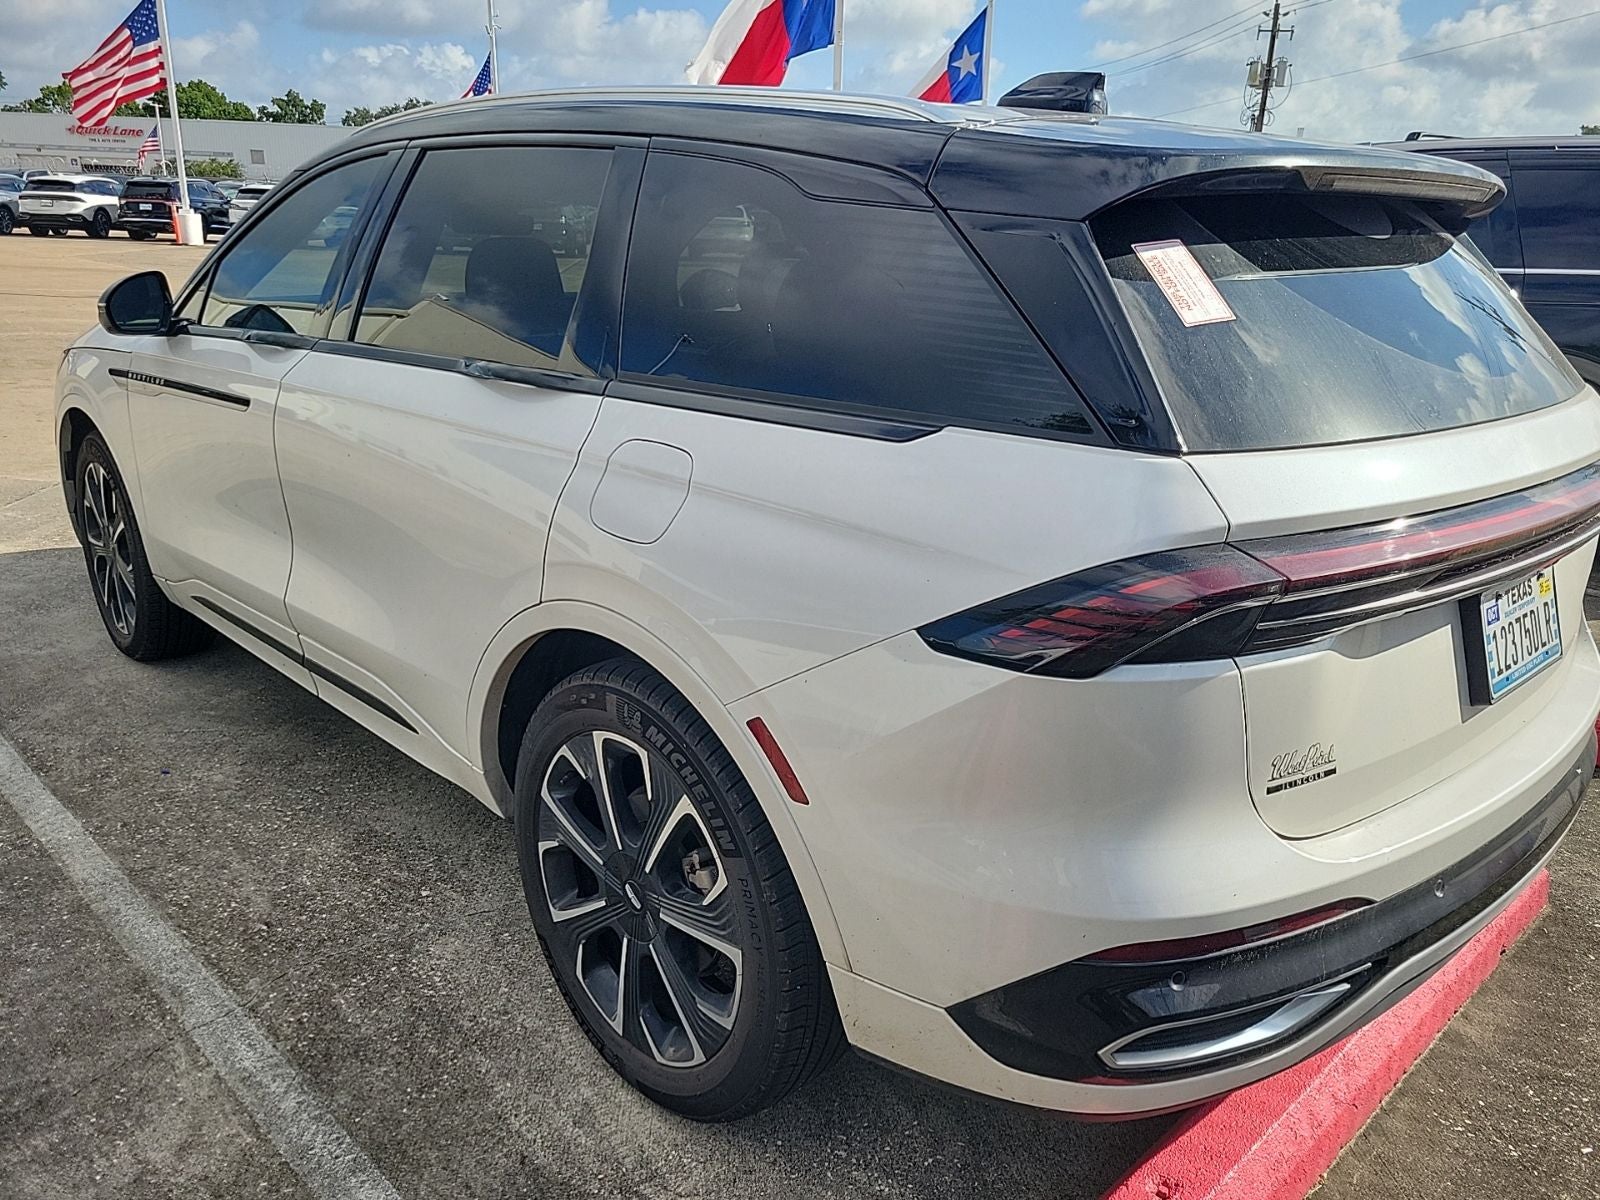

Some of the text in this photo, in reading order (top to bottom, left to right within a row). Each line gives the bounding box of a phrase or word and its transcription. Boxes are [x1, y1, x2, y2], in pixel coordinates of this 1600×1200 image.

[75, 125, 144, 137] Quick Lane
[1504, 579, 1532, 607] TEXAS
[1492, 601, 1554, 677] 12375DLR
[645, 726, 736, 851] MICHELIN
[1284, 772, 1325, 789] LINCOLN
[738, 877, 764, 951] PRIMACY
